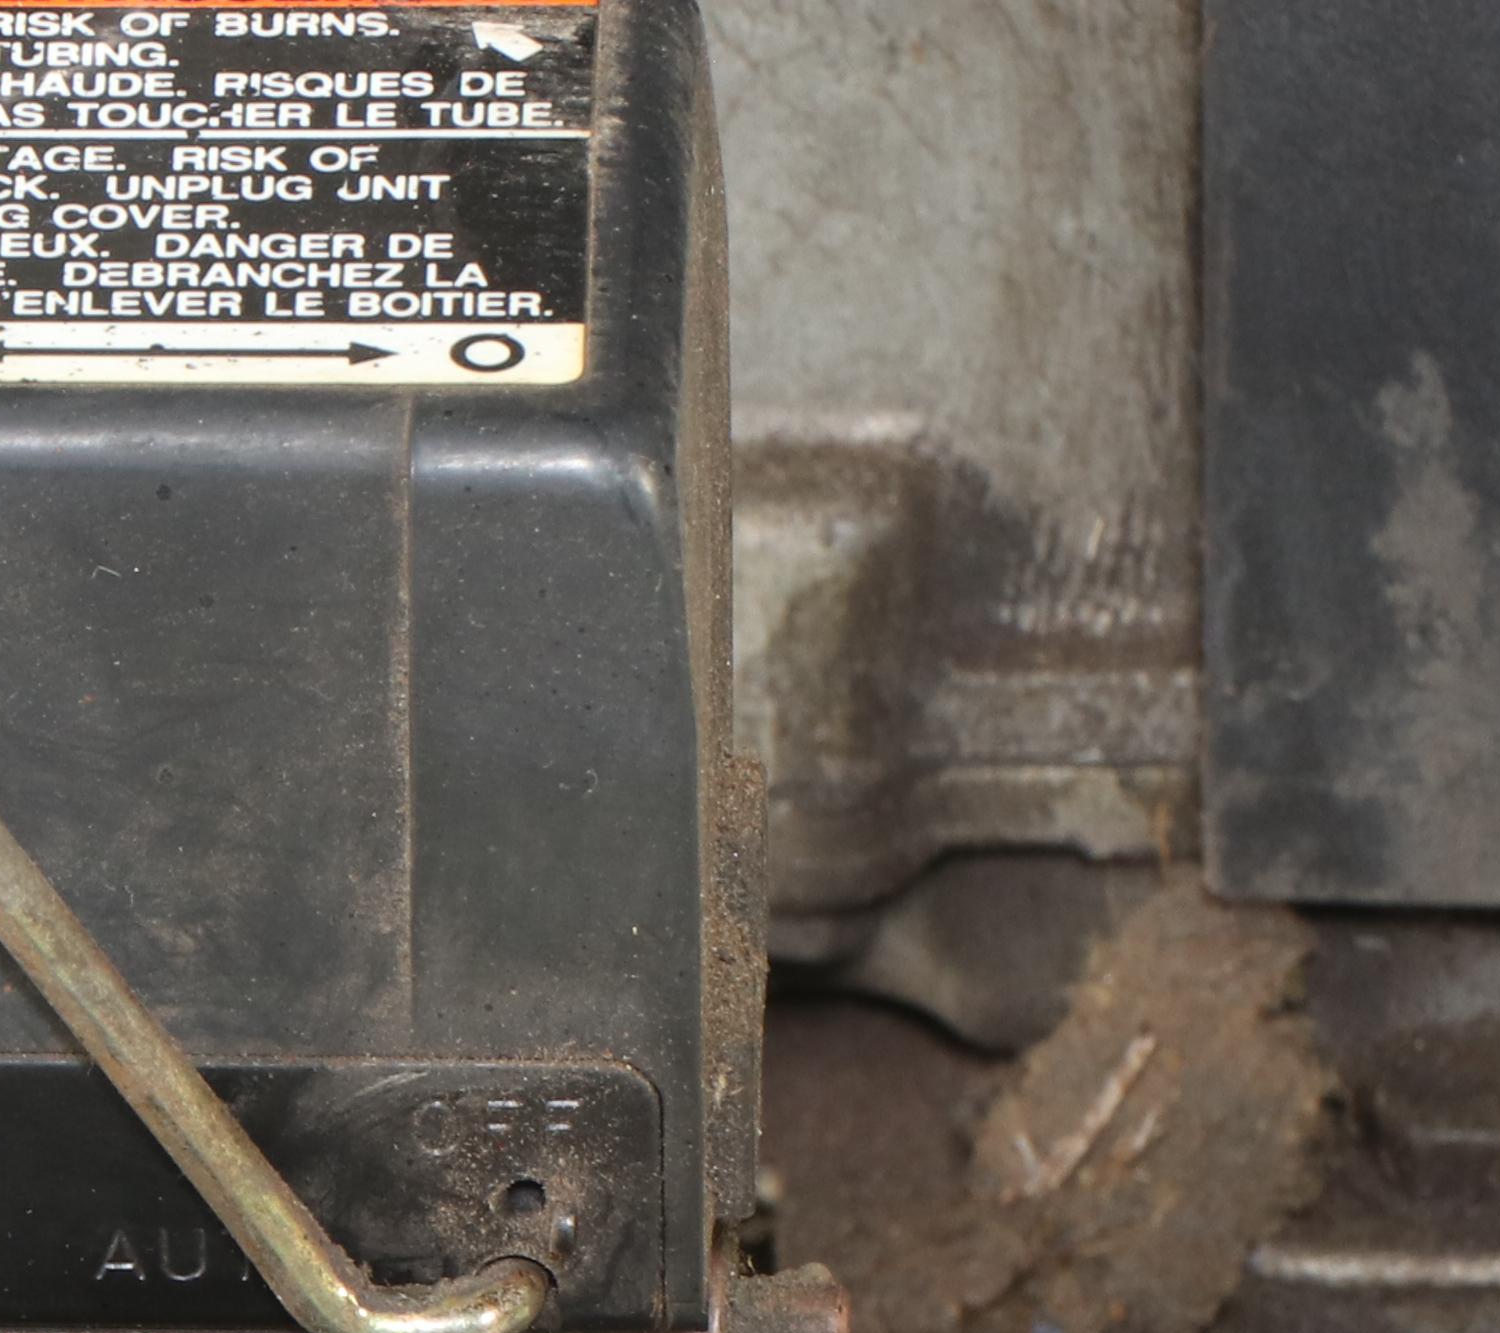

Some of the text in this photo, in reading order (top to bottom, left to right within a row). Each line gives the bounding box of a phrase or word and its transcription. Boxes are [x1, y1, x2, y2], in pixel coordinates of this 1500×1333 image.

[121, 11, 190, 37] OF
[215, 11, 400, 37] BURNS.
[214, 72, 433, 98] RISQUES
[460, 73, 528, 99] DE
[68, 103, 311, 129] TOUCHER
[336, 104, 397, 130] LE
[420, 104, 564, 130] TUBE.
[172, 145, 286, 172] RISK
[310, 146, 379, 173] OF
[107, 175, 313, 201] UNPLUG
[53, 204, 240, 230] COVER.
[155, 232, 364, 258] DANGER
[388, 233, 454, 259] DE
[425, 262, 489, 289] LA
[265, 290, 325, 316] LE
[348, 291, 554, 317] BOITIER.
